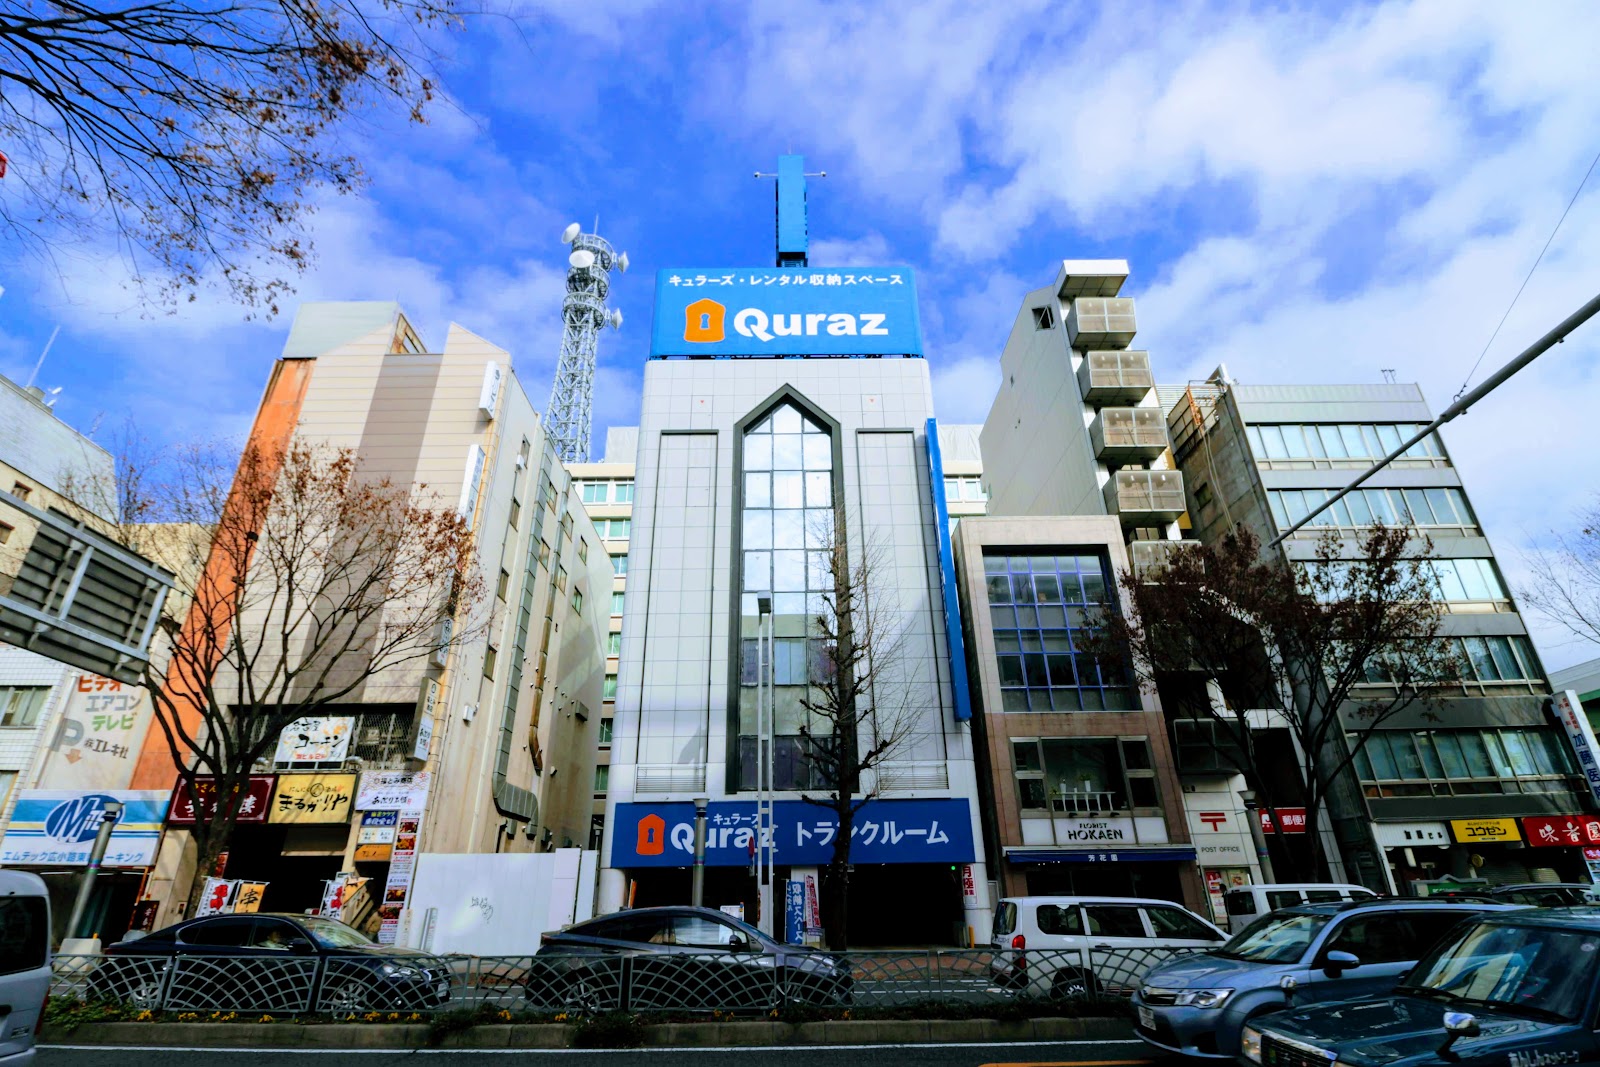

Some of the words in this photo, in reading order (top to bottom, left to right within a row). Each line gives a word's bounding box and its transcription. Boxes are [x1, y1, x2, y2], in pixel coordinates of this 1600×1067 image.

[669, 274, 903, 286] キュラーズ・レンタル収納スペース
[734, 307, 889, 342] Quraz
[85, 694, 141, 713] エアコン
[92, 712, 138, 731] テレビ
[294, 733, 345, 749] コーチン
[278, 793, 348, 813] まるがりや
[797, 820, 949, 846] トラクルーム
[1067, 830, 1123, 840] HOKAEN
